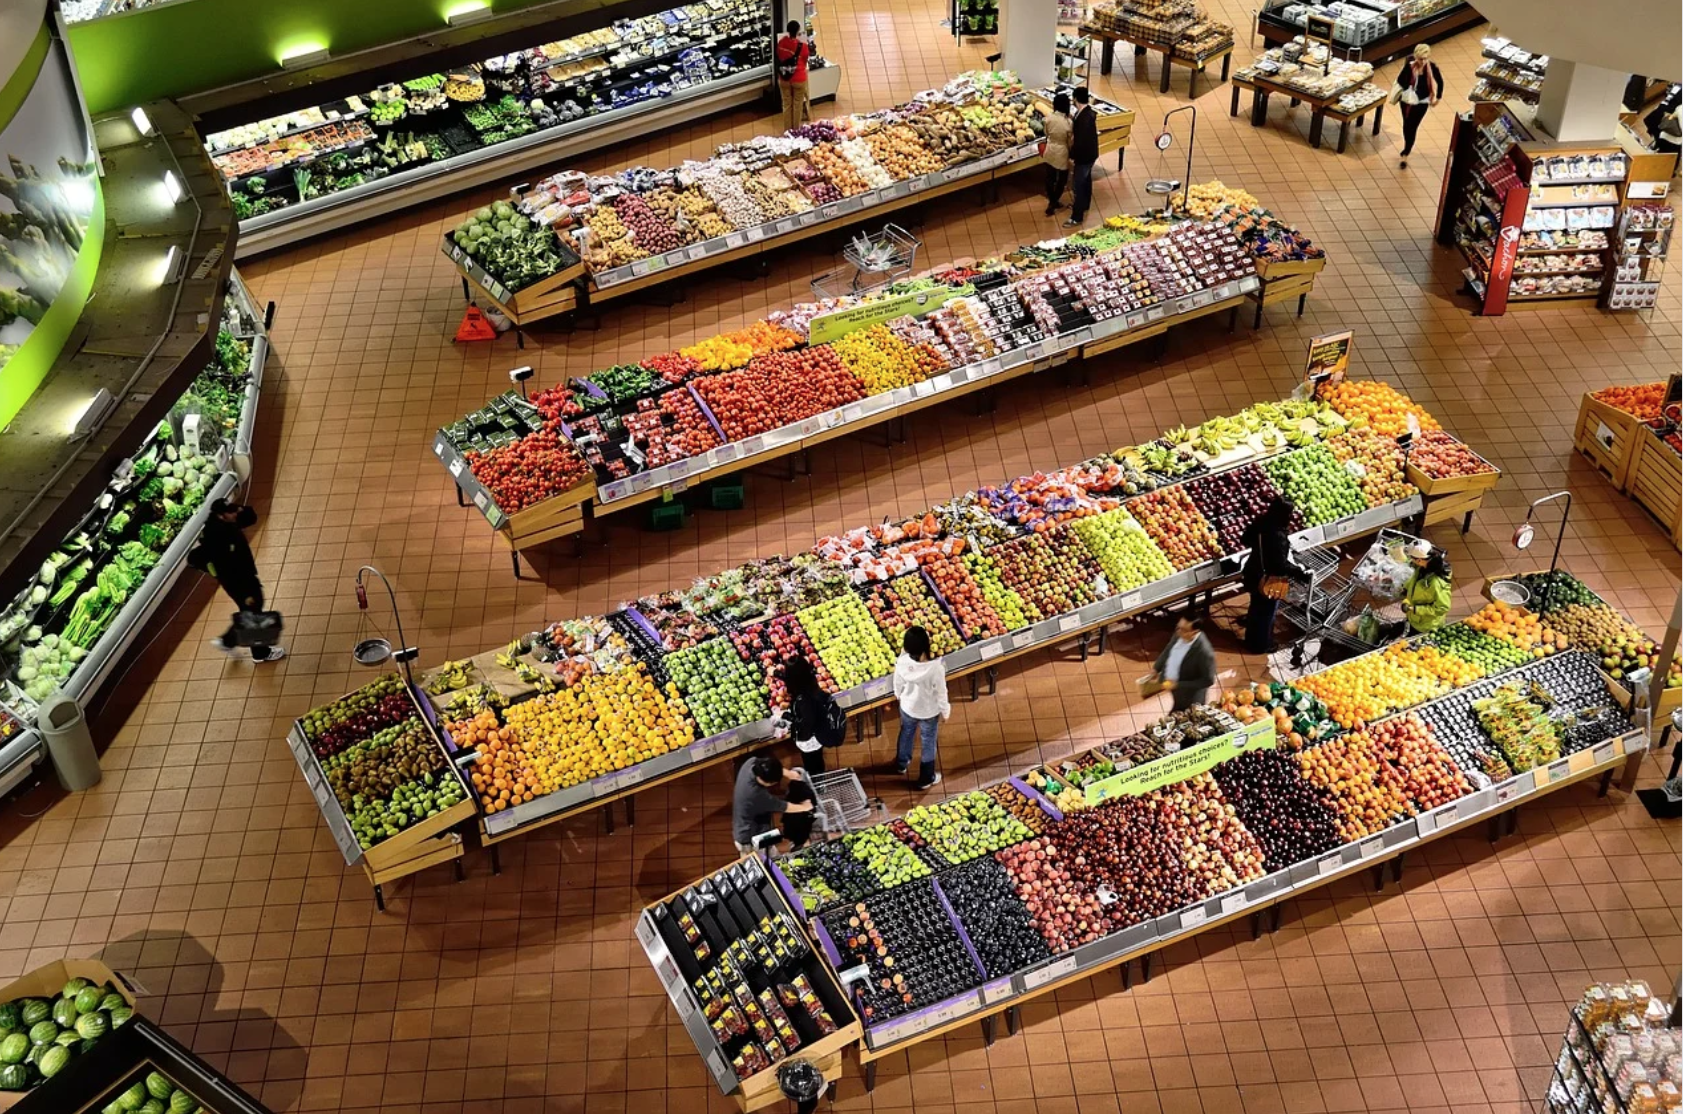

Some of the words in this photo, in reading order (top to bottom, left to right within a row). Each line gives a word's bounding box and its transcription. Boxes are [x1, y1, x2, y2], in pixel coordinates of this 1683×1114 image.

[835, 312, 856, 321] Looking
[1120, 770, 1149, 785] Looking
[1150, 765, 1161, 774] for
[1162, 751, 1197, 770] nutritious
[1198, 738, 1229, 755] choices?
[1139, 771, 1162, 785] Reach
[1163, 767, 1174, 777] for
[1176, 763, 1188, 771] the
[1188, 753, 1211, 767] Stars!
